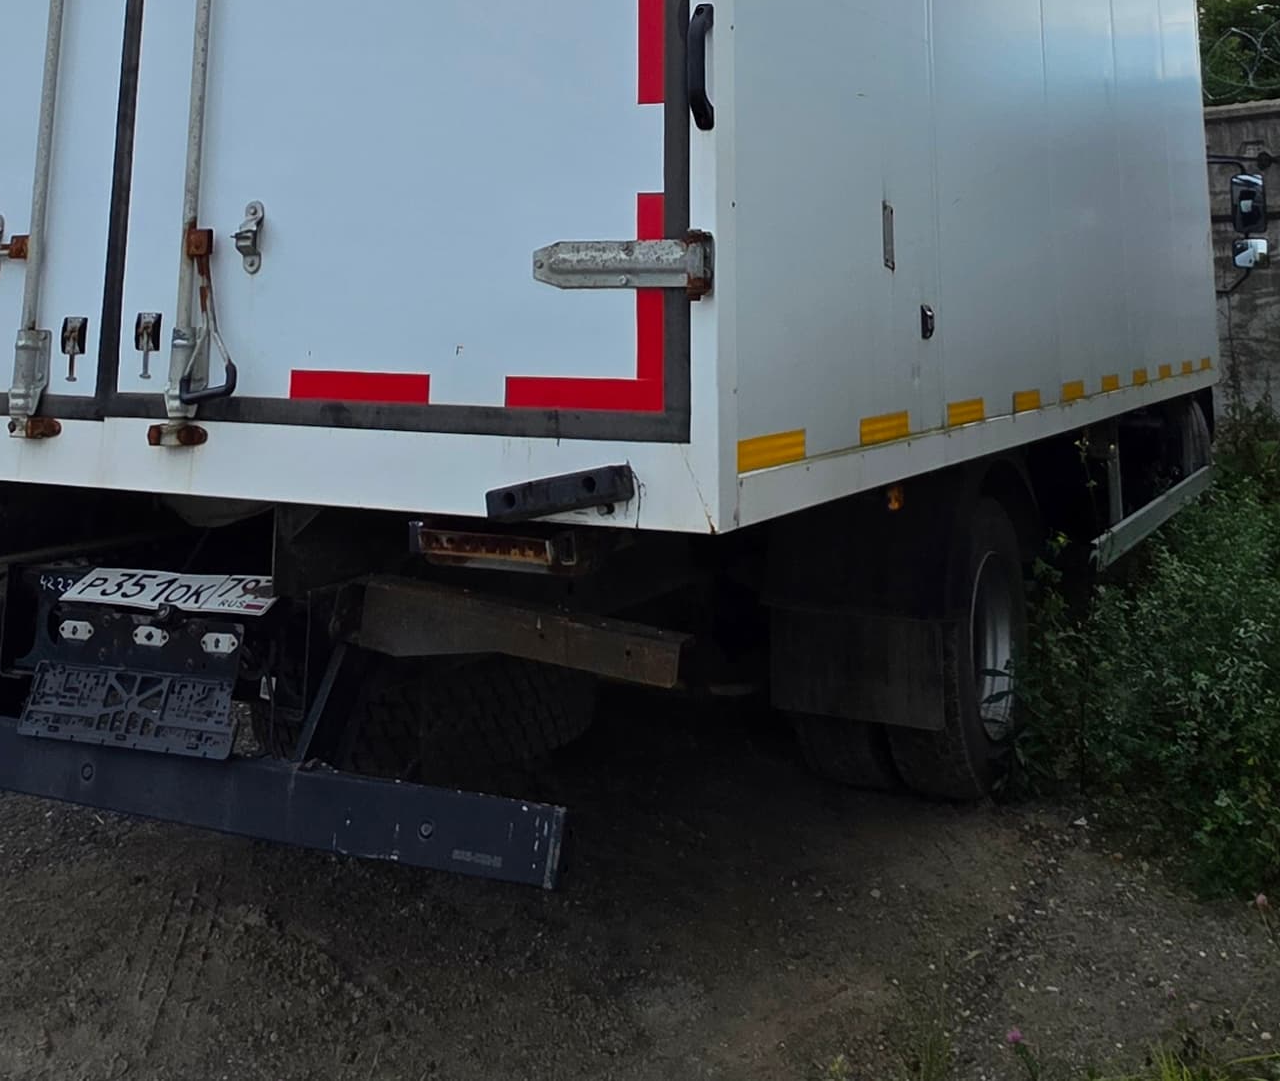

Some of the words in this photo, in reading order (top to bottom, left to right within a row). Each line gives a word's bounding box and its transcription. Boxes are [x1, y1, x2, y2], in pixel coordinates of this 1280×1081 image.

[77, 572, 217, 605] Р351ОК
[218, 578, 273, 599] 79
[218, 599, 246, 608] RUS
